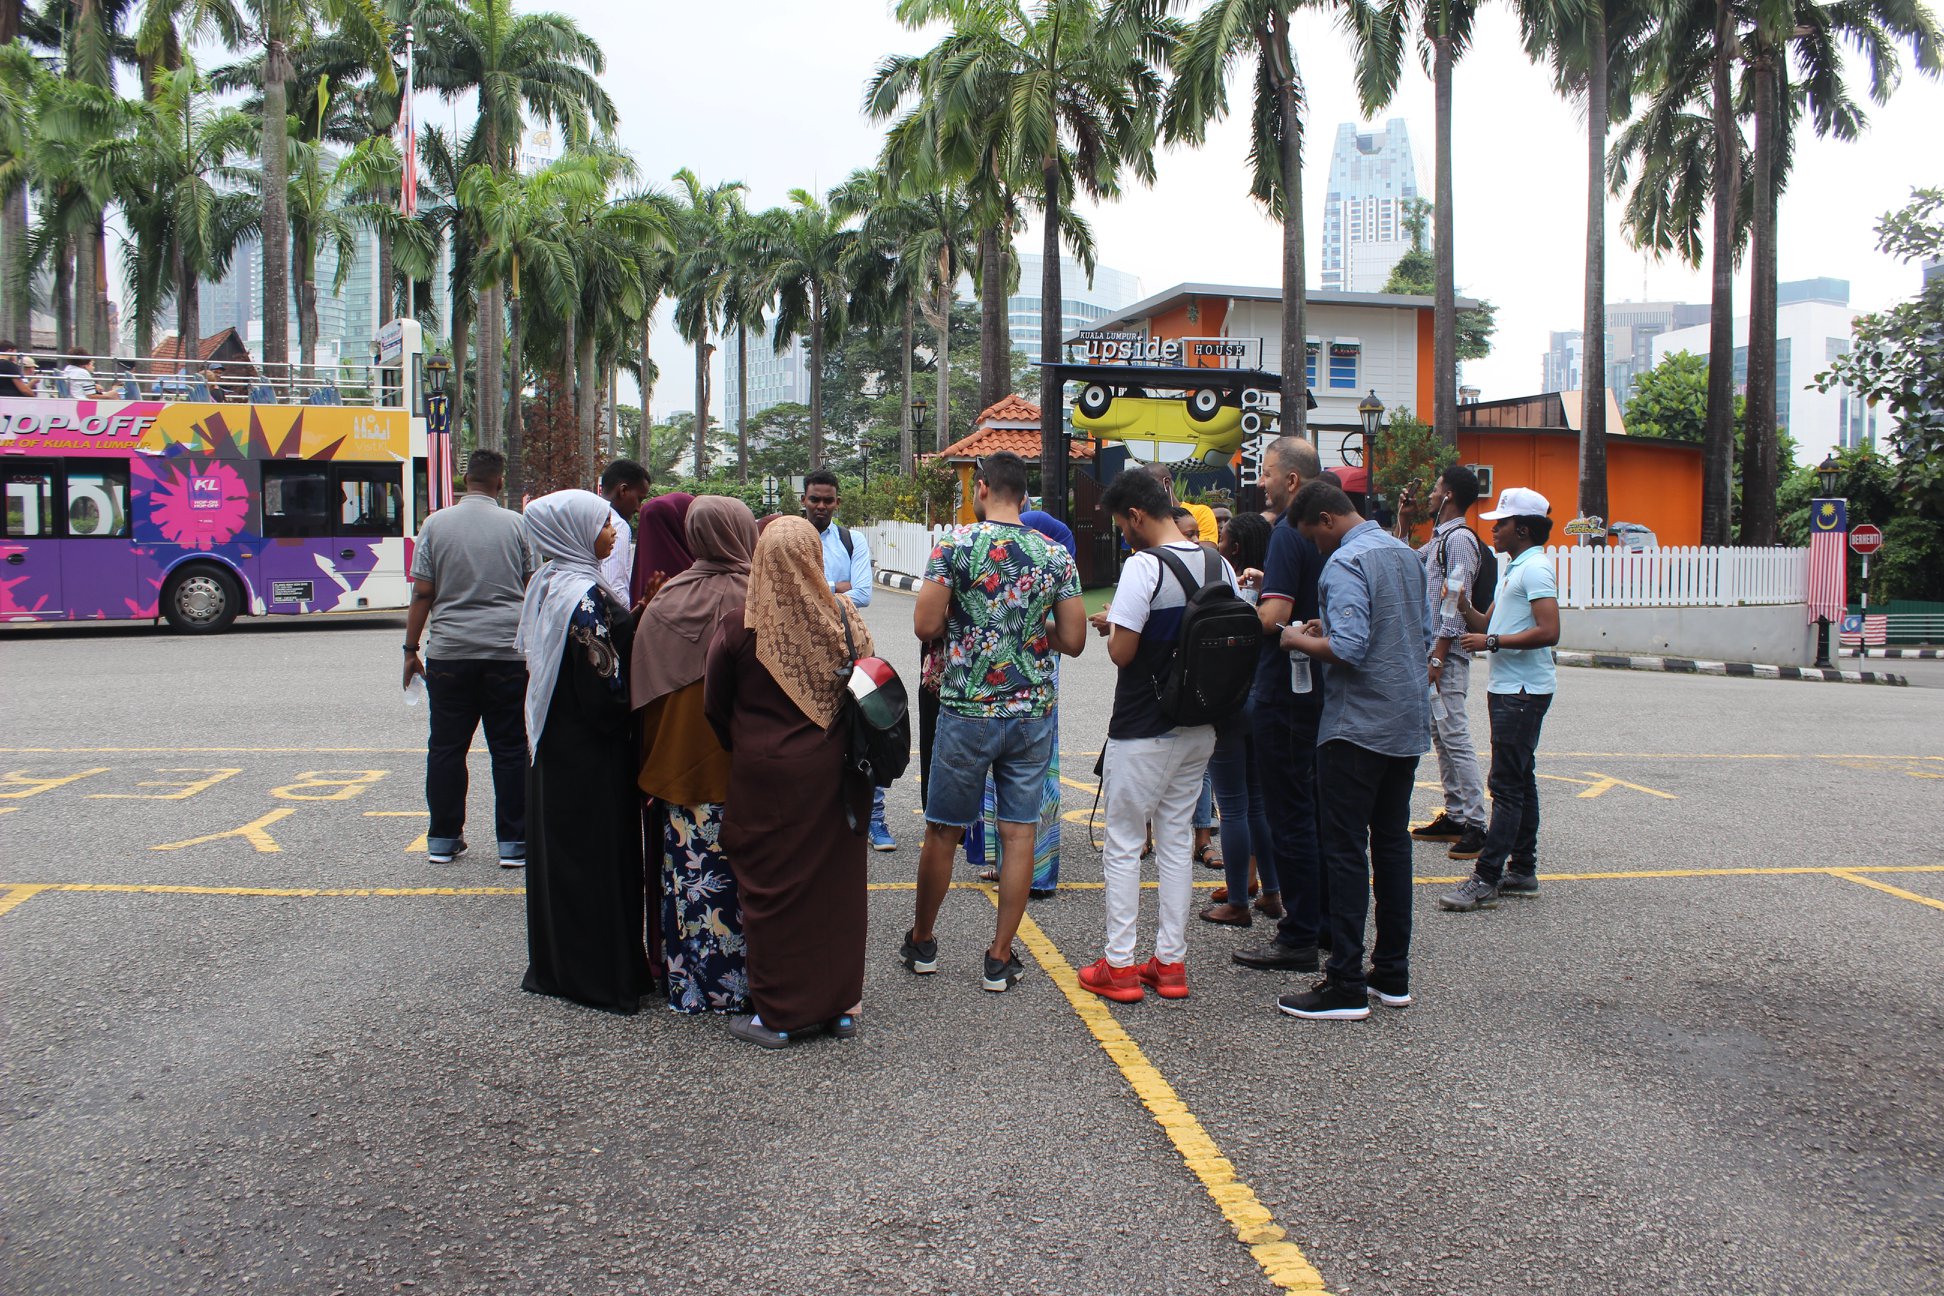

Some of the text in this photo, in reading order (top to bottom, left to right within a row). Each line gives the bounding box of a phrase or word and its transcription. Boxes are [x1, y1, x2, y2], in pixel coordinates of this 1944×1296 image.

[1080, 331, 1137, 341] KUALA LUMPUR
[1085, 335, 1179, 362] upside
[1194, 344, 1243, 356] HOUSE
[19, 438, 40, 448] OF
[43, 439, 91, 449] KUALA
[95, 440, 152, 450] LUMPUR
[1241, 388, 1264, 488] down
[194, 479, 219, 491] KL
[1851, 534, 1879, 545] BERHENTI
